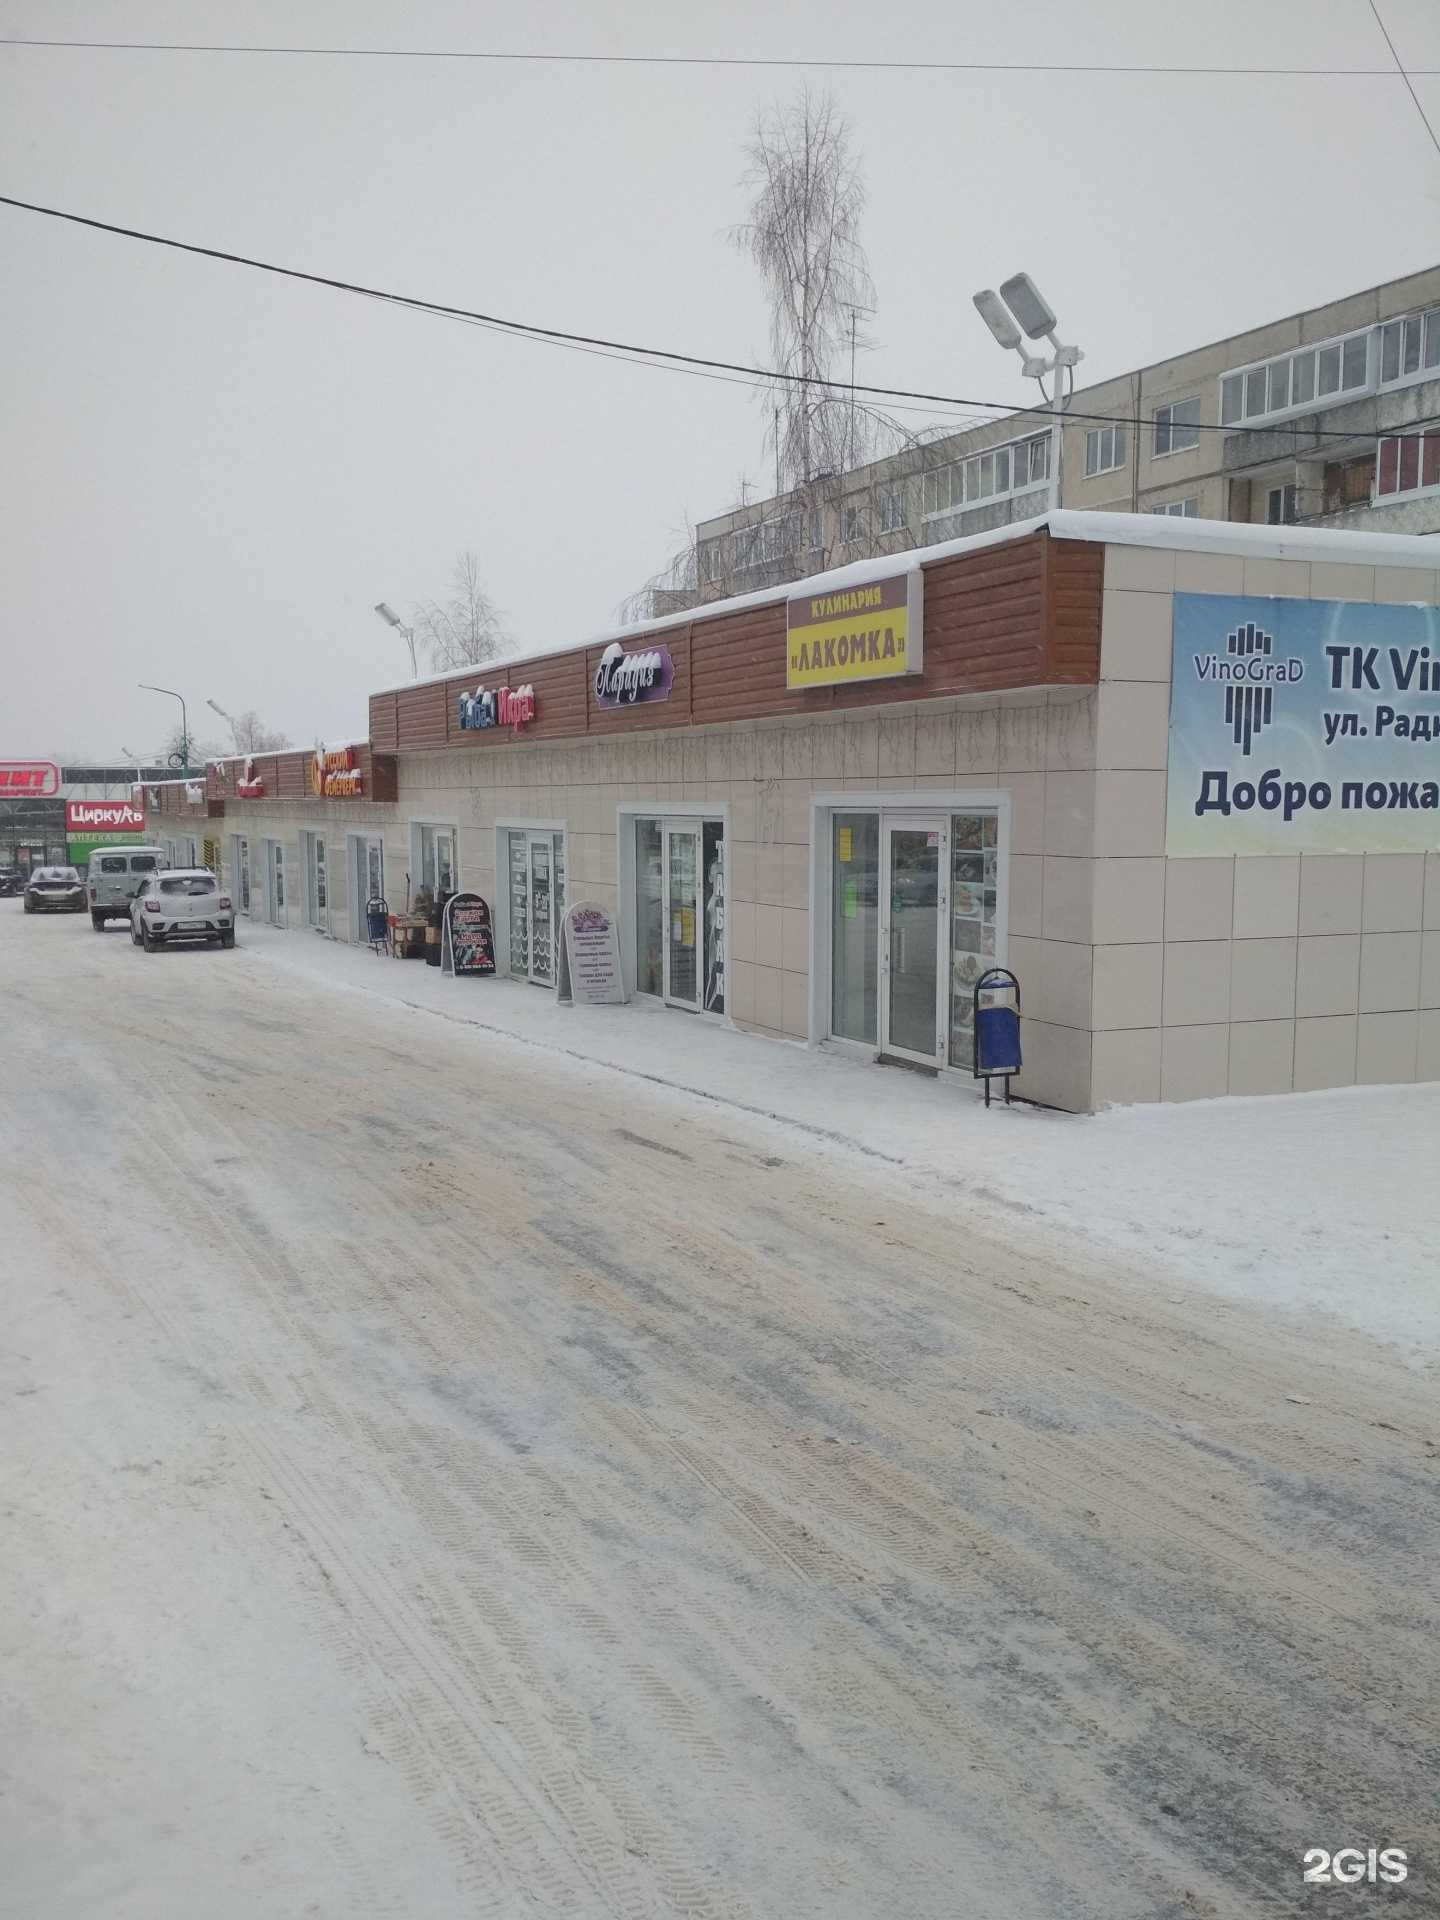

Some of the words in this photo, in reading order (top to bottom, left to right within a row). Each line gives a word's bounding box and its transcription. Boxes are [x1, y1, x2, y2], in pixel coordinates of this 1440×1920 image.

[811, 586, 882, 618] КУЛИНАРИЯ
[1194, 655, 1304, 682] VinoGraD
[1325, 646, 1381, 690] ТК
[1323, 712, 1368, 745] ул.
[1195, 768, 1332, 821] Добро
